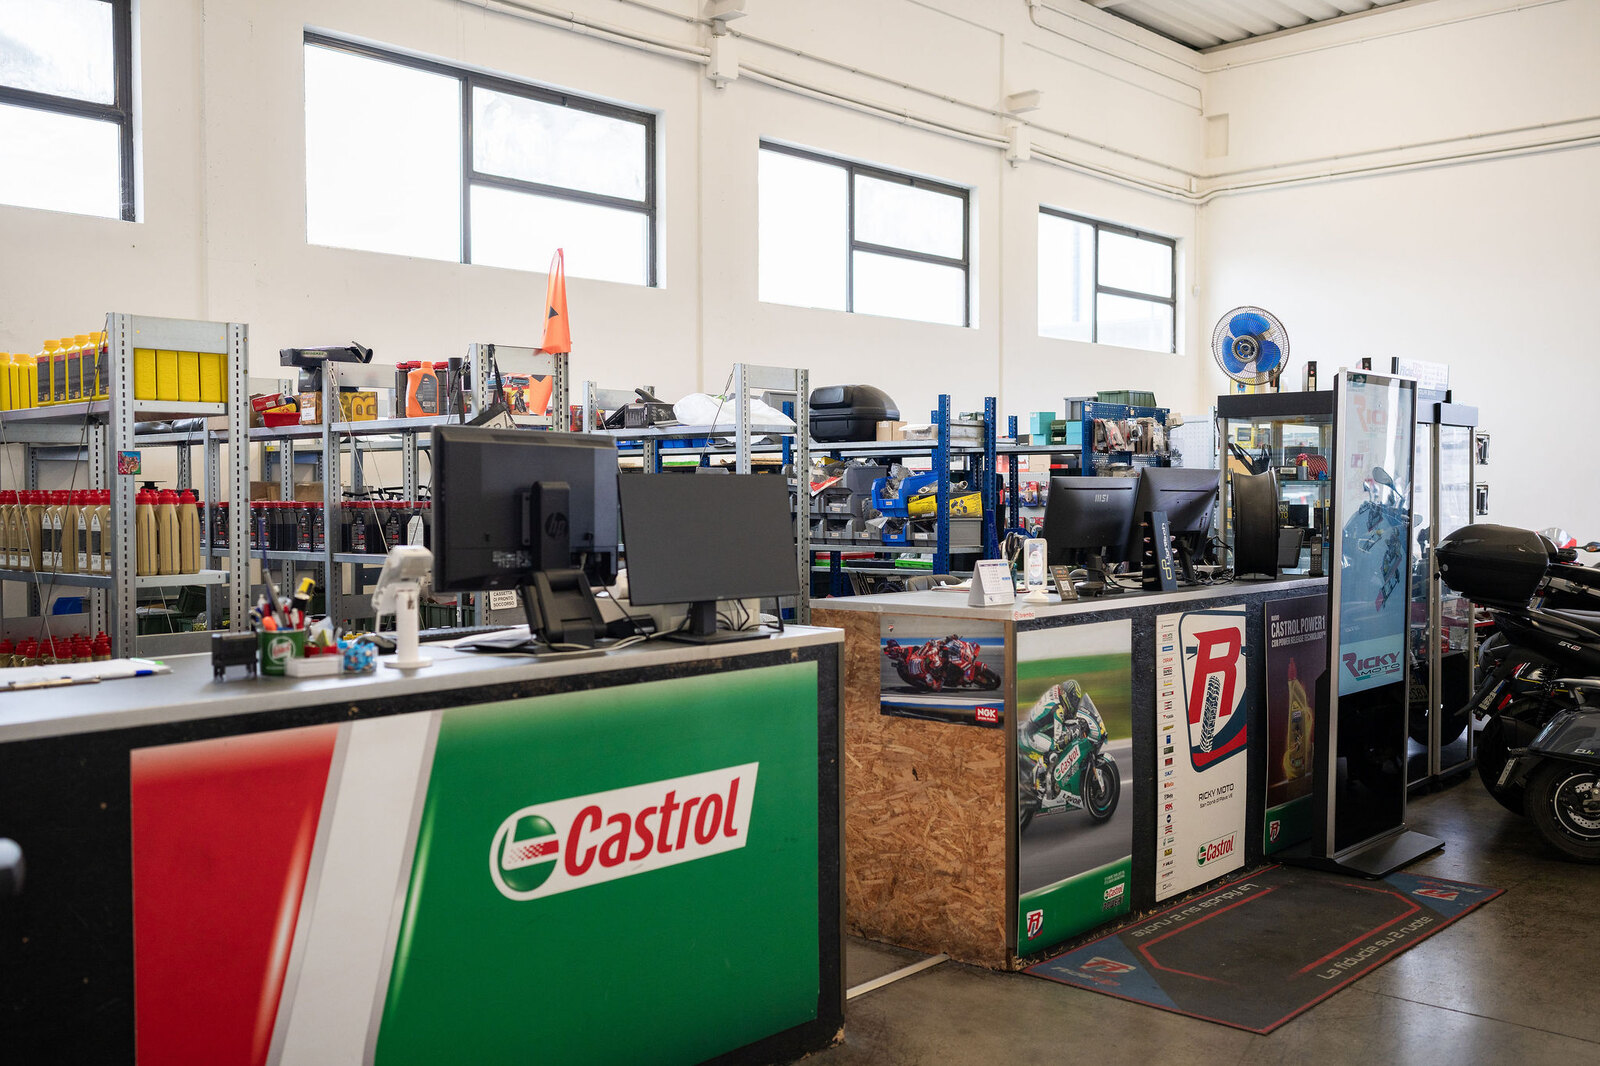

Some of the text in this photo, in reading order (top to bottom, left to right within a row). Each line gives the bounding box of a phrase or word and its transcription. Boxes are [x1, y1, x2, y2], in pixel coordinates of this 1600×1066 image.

[1094, 494, 1109, 503] MSI
[1271, 619, 1300, 638] CASTROL
[1300, 615, 1326, 633] POWER1
[1279, 636, 1291, 646] POWER
[1342, 651, 1400, 678] RICKY
[1361, 663, 1400, 676] MOTO
[977, 708, 996, 718] NGK
[1060, 746, 1079, 774] Castrol
[1198, 783, 1234, 801] RICKY MOTO
[564, 777, 740, 876] Castrol
[1206, 835, 1235, 861] Castrol
[1130, 919, 1172, 937] ruote
[1317, 916, 1434, 980] La fiducia su 2 ruote
